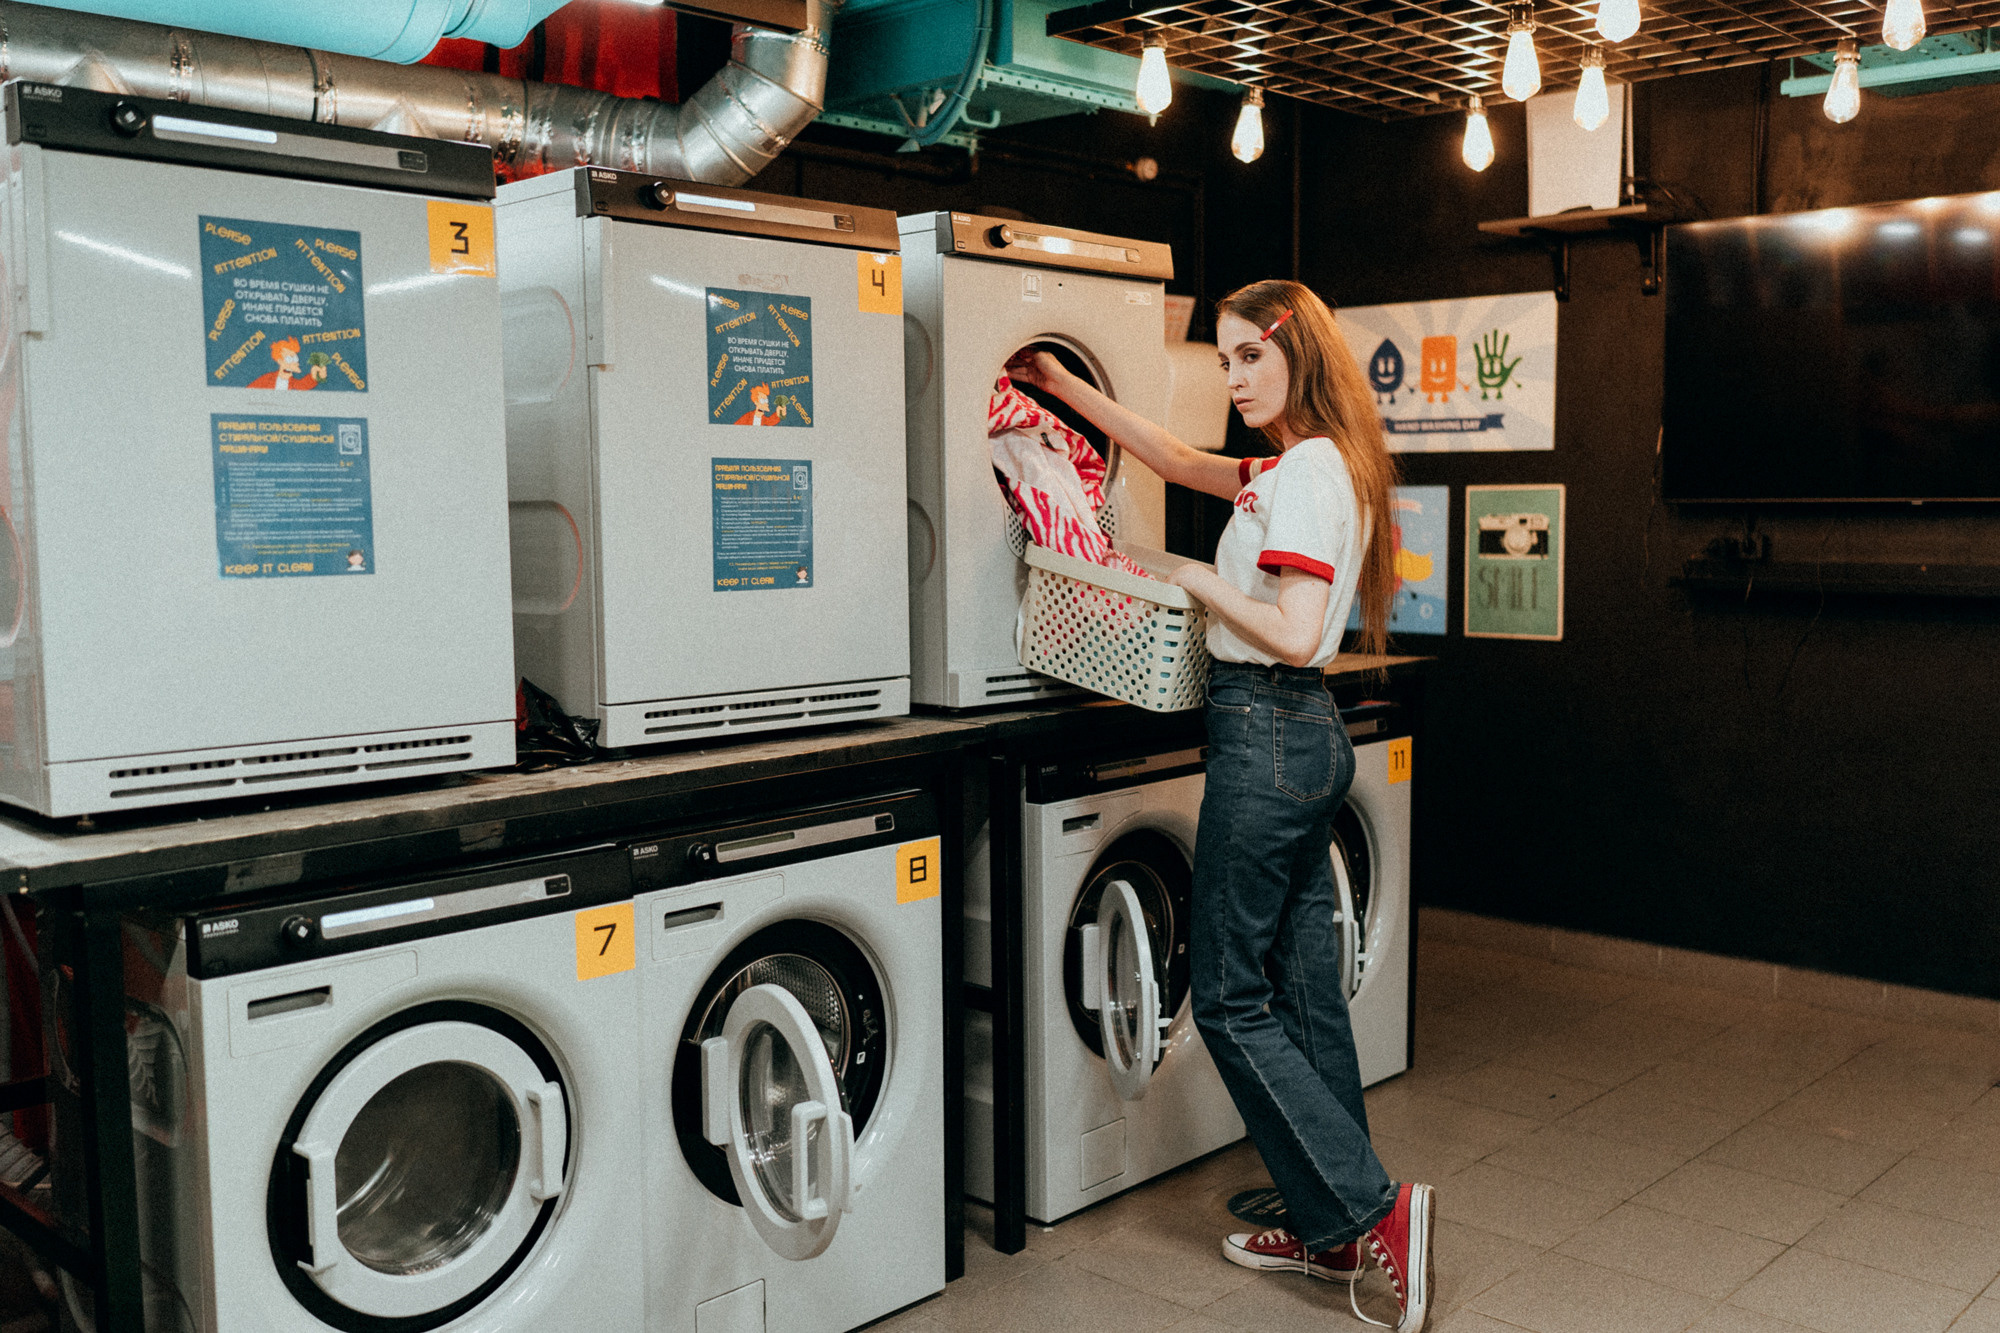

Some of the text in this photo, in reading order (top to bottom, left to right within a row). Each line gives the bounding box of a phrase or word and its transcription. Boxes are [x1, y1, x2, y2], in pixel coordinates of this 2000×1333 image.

[34, 86, 62, 98] ASKO
[599, 171, 617, 180] ASKO
[205, 222, 251, 245] PLEASE
[449, 221, 469, 255] 3
[314, 238, 357, 260] PLEASE
[214, 247, 277, 275] ATTENTION
[295, 238, 346, 293] ATTENTION
[233, 278, 330, 294] ВО ВРЕМЯ СУШКИ НЕ
[872, 269, 885, 296] 4
[235, 290, 329, 307] ОТКРЫВАТЬ ДВЕРЦУ,
[242, 302, 323, 316] ИНАЧЕ ПРИДЕТСЯ
[244, 313, 322, 327] СНОВА ПЛАТИТЬ
[715, 312, 757, 334] ATTENTION
[767, 304, 800, 347] ATTENTION
[302, 328, 361, 344] ATTENTION
[738, 337, 757, 346] ВРЕМЯ
[758, 339, 781, 347] СУШКИ
[781, 341, 789, 349] НЕ
[214, 330, 266, 380] ATTENTION
[728, 346, 763, 355] ОТКРЫВАТЬ
[732, 356, 785, 366] ИНАЧЕ ПРИДЕТСЯ
[734, 364, 784, 375] СНОВА ПЛАТИТЬ
[771, 375, 810, 389] ATTENTION
[713, 378, 748, 418] ATTENTION
[225, 562, 314, 574] KEEP IT CLEAN
[717, 576, 775, 586] KEEP IT CLEAN
[1393, 750, 1405, 771] 11
[640, 845, 659, 855] ASKO
[910, 854, 927, 884] 8
[212, 919, 239, 932] ASKO
[593, 922, 617, 956] 7
